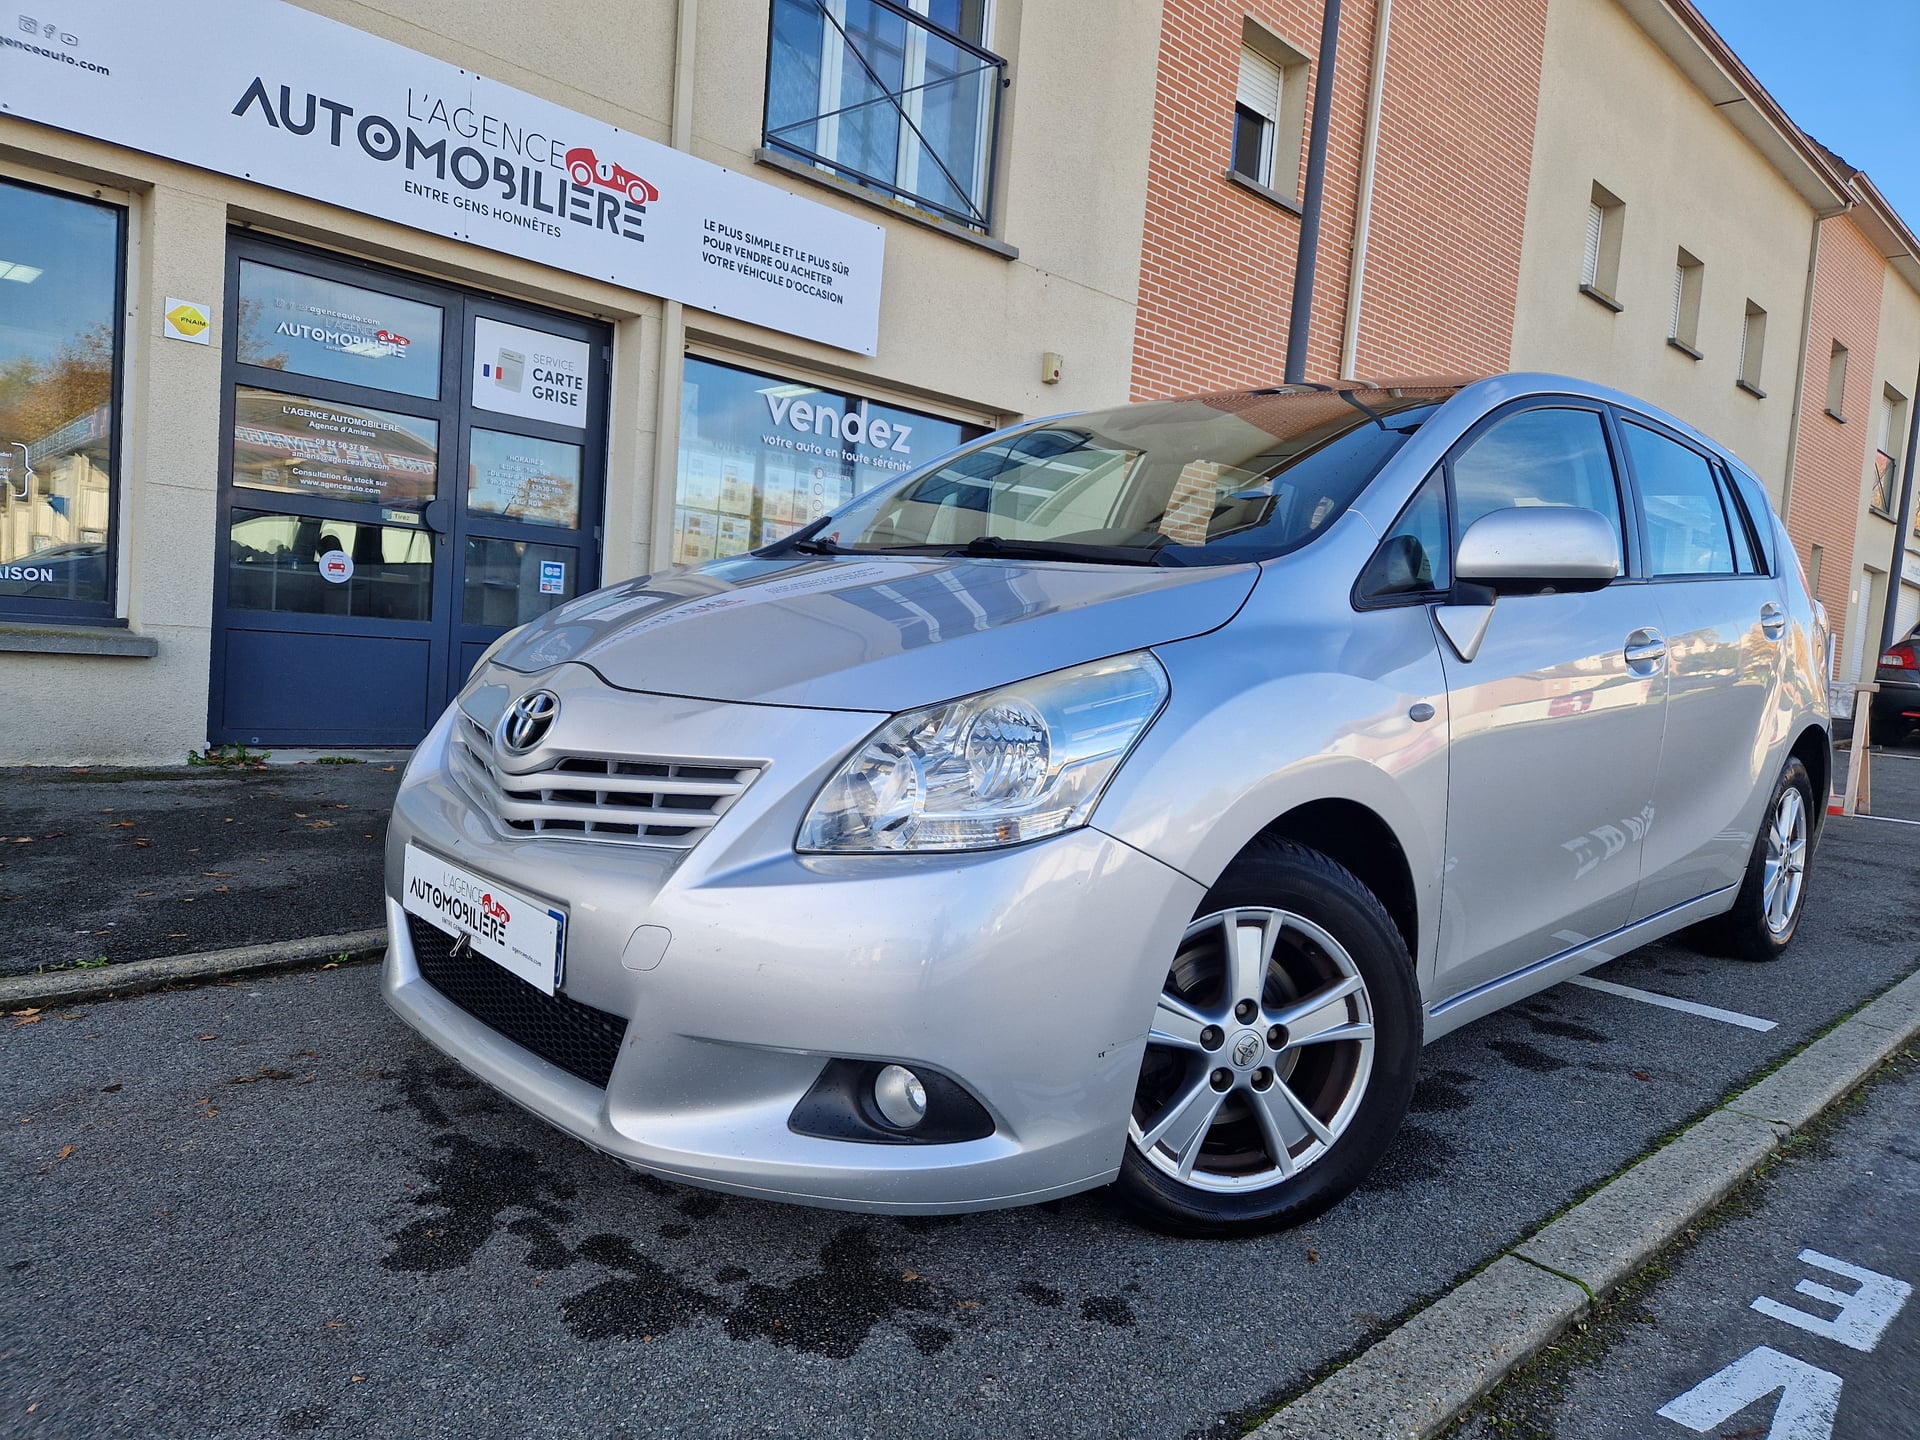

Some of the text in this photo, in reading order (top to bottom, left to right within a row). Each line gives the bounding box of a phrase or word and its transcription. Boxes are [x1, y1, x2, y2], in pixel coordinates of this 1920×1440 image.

[407, 88, 567, 171] L'AGENCE
[404, 180, 562, 238] ENTRE GENS HONNÊTES
[704, 218, 850, 277] LE PLUS SIMPLE ET LE PLUS SÛR
[703, 235, 833, 286] POUR VENDRE OU ACHETER
[702, 251, 843, 305] VOTRE VÉHICULE D'OCCASION
[180, 316, 206, 327] FNAIM
[309, 306, 381, 325] agenceauto.com
[533, 353, 575, 371] SERVICE
[532, 368, 583, 390] CARTE
[532, 386, 578, 407] GRISE
[282, 405, 401, 433] L'AGENCE AUTOMOBILIERE
[309, 420, 376, 438] Agence d'Amiens
[764, 393, 914, 454] vendez
[292, 451, 390, 471] amiens@agenceauto.com
[510, 455, 544, 466] HORAIRES
[762, 434, 793, 450] votre
[795, 440, 822, 455] auto
[824, 447, 839, 459] en
[841, 448, 870, 465] toute
[872, 455, 912, 472] sérénité
[292, 467, 341, 481] Consultation
[342, 474, 352, 482] du
[354, 477, 375, 486] stock
[300, 479, 381, 495] www.agenceauto.com
[443, 871, 483, 906] L'AGENCE
